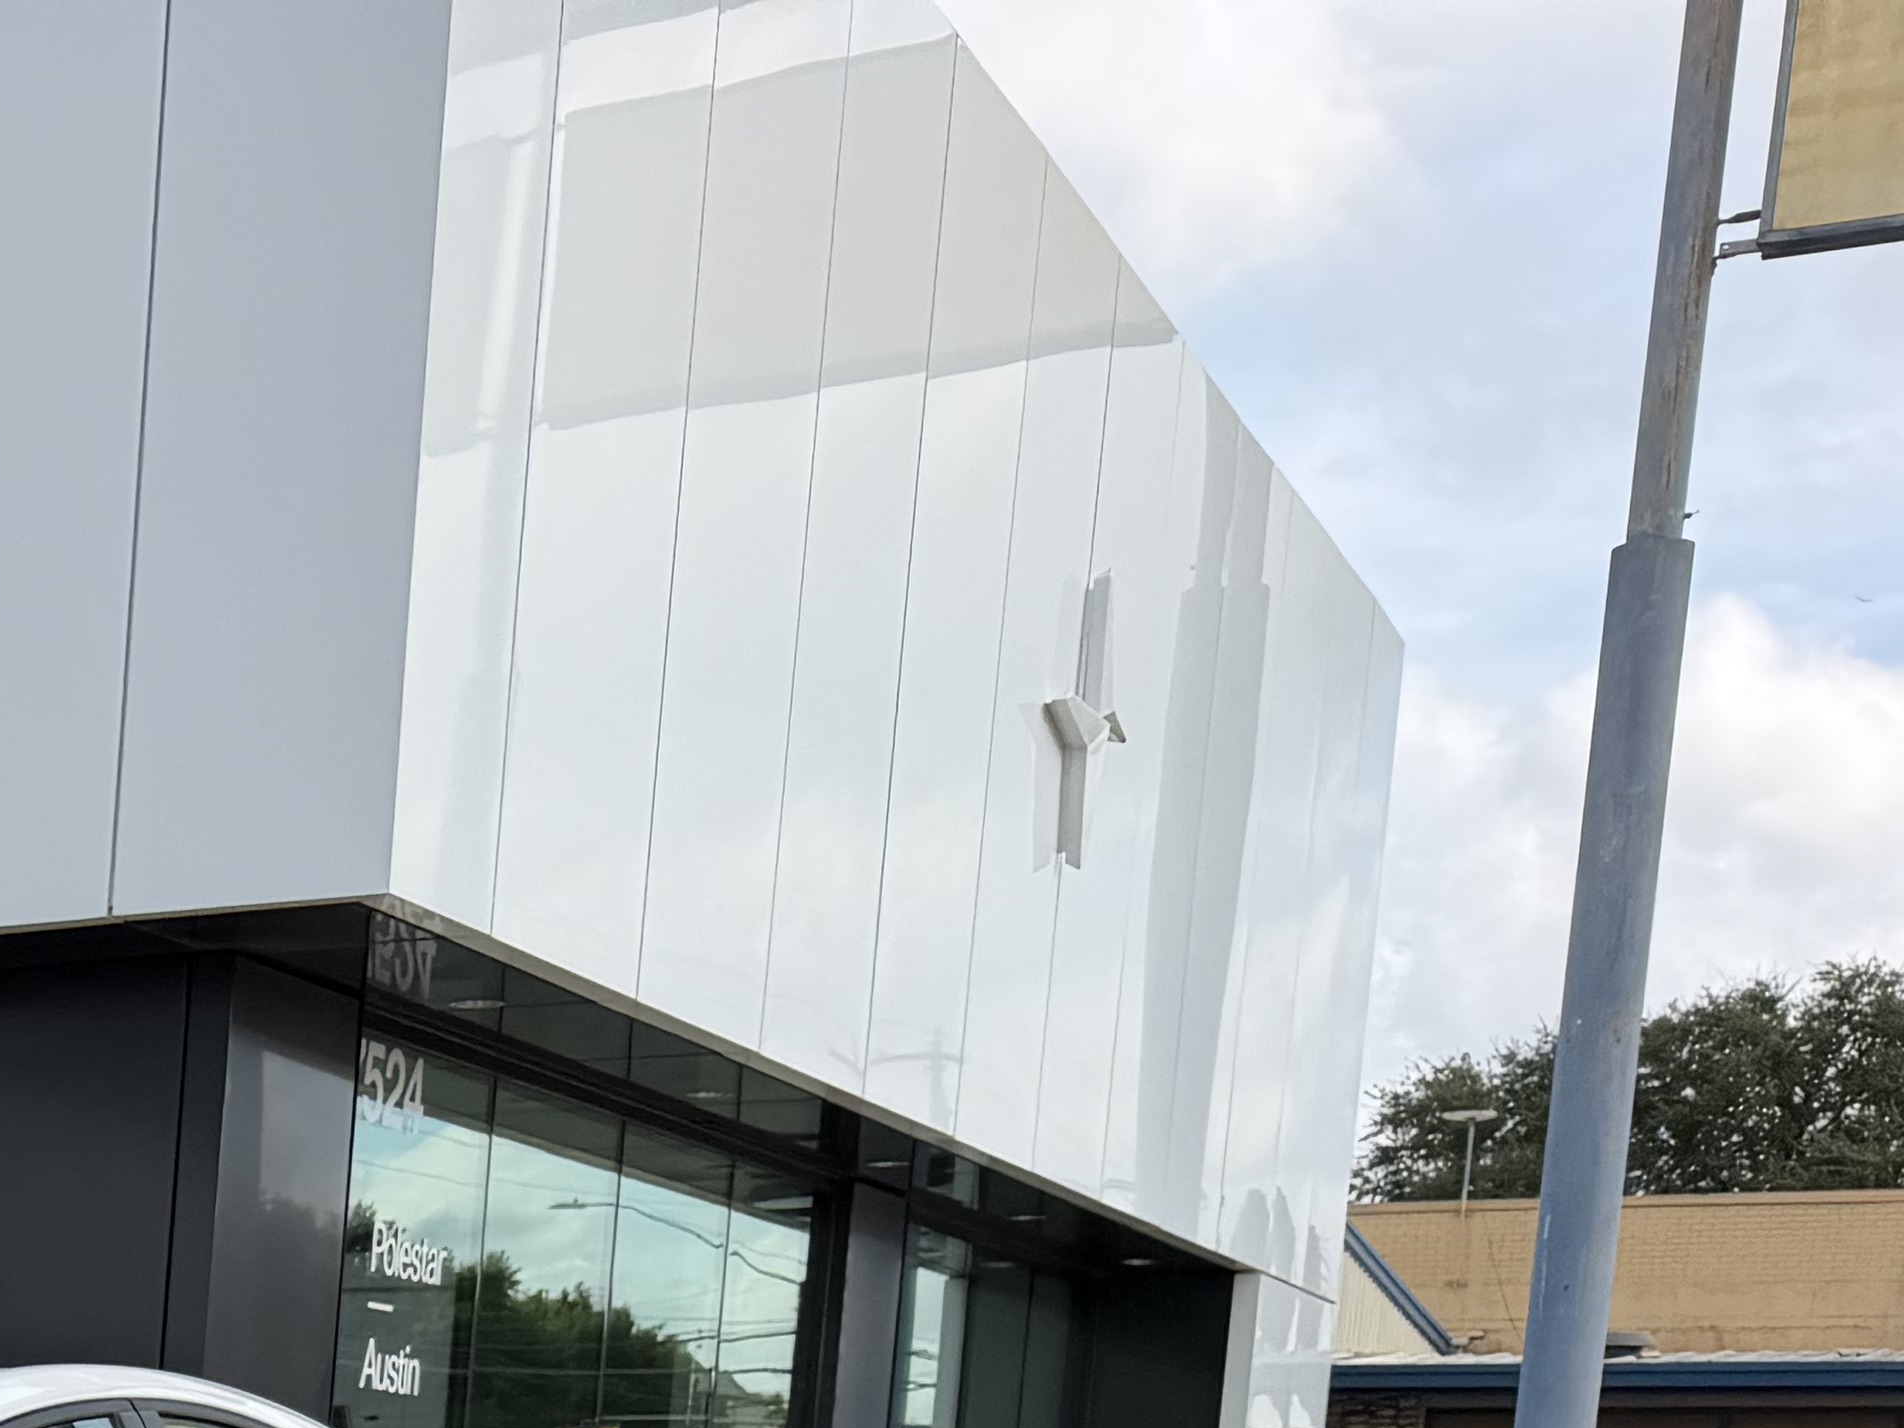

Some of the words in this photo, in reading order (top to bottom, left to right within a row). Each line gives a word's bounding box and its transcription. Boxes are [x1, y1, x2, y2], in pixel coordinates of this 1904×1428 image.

[359, 1036, 424, 1128] 524
[370, 1221, 448, 1286] Polestar
[358, 1337, 421, 1396] Austin
